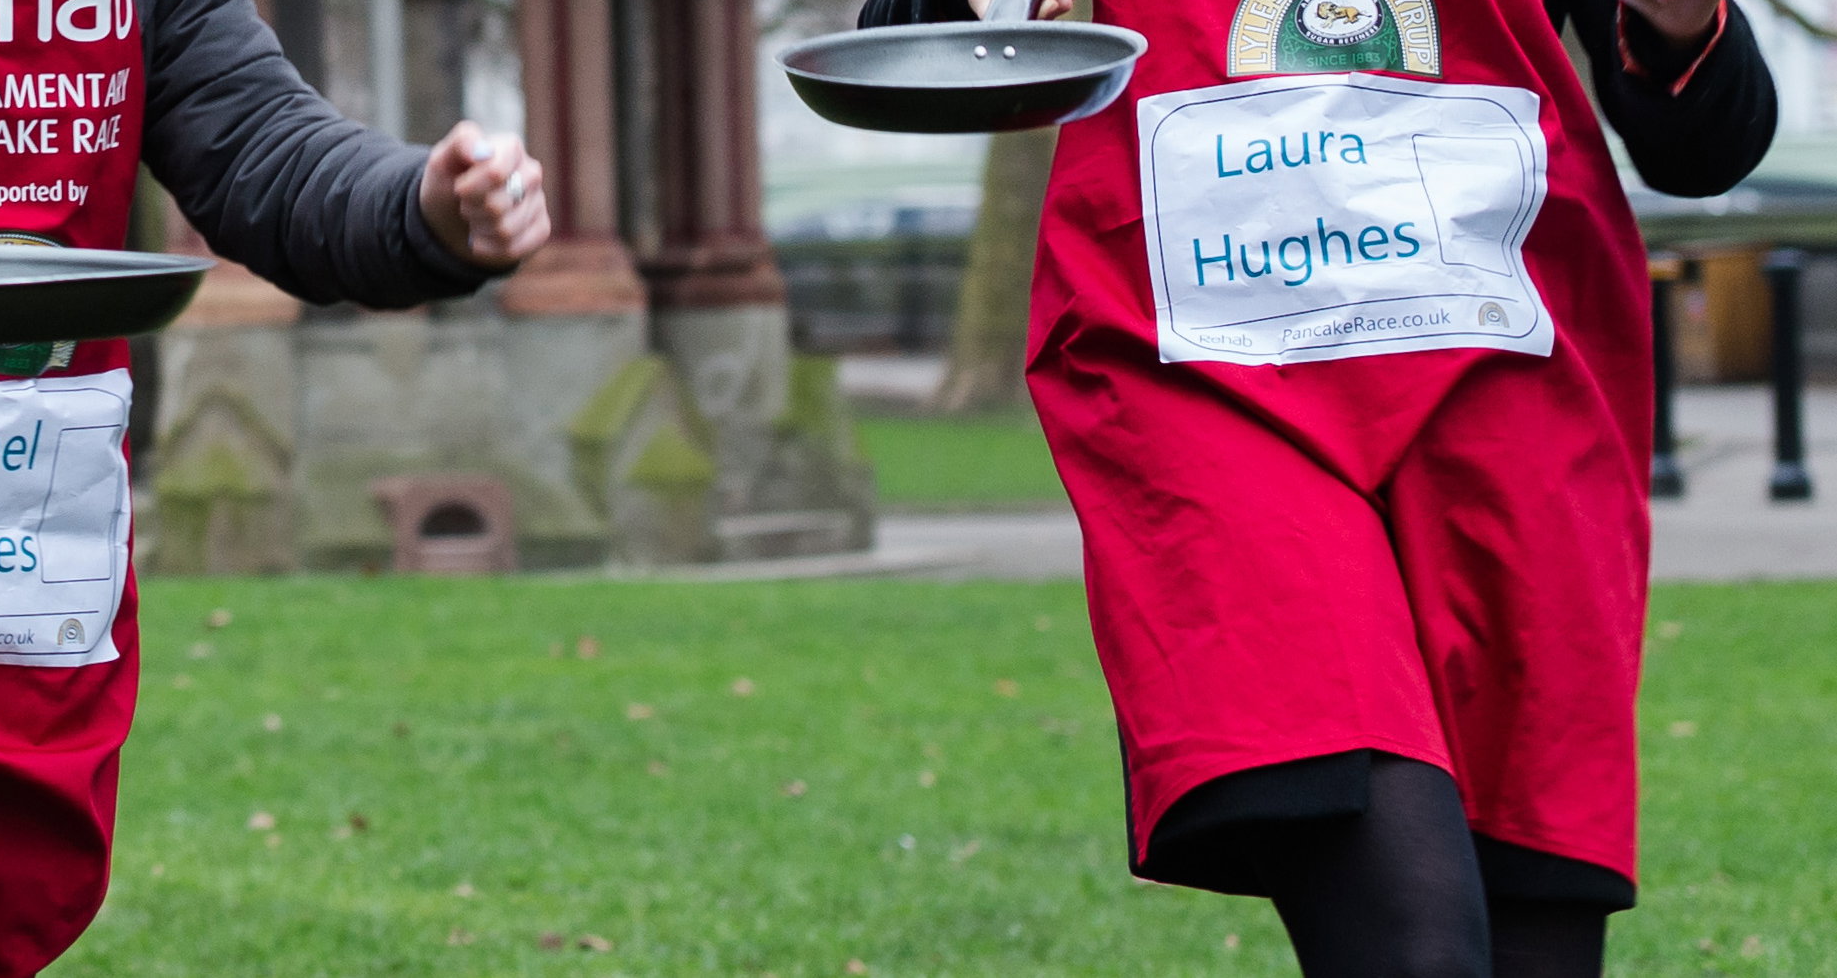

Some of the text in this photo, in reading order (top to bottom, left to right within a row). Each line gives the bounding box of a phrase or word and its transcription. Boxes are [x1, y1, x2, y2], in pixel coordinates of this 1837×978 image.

[1307, 52, 1381, 67] SINCE 1883
[1216, 130, 1368, 179] Laura
[69, 182, 89, 206] by
[1193, 217, 1421, 288] Hughes
[1198, 307, 1452, 348] Rehab PancakeRace.co.uk
